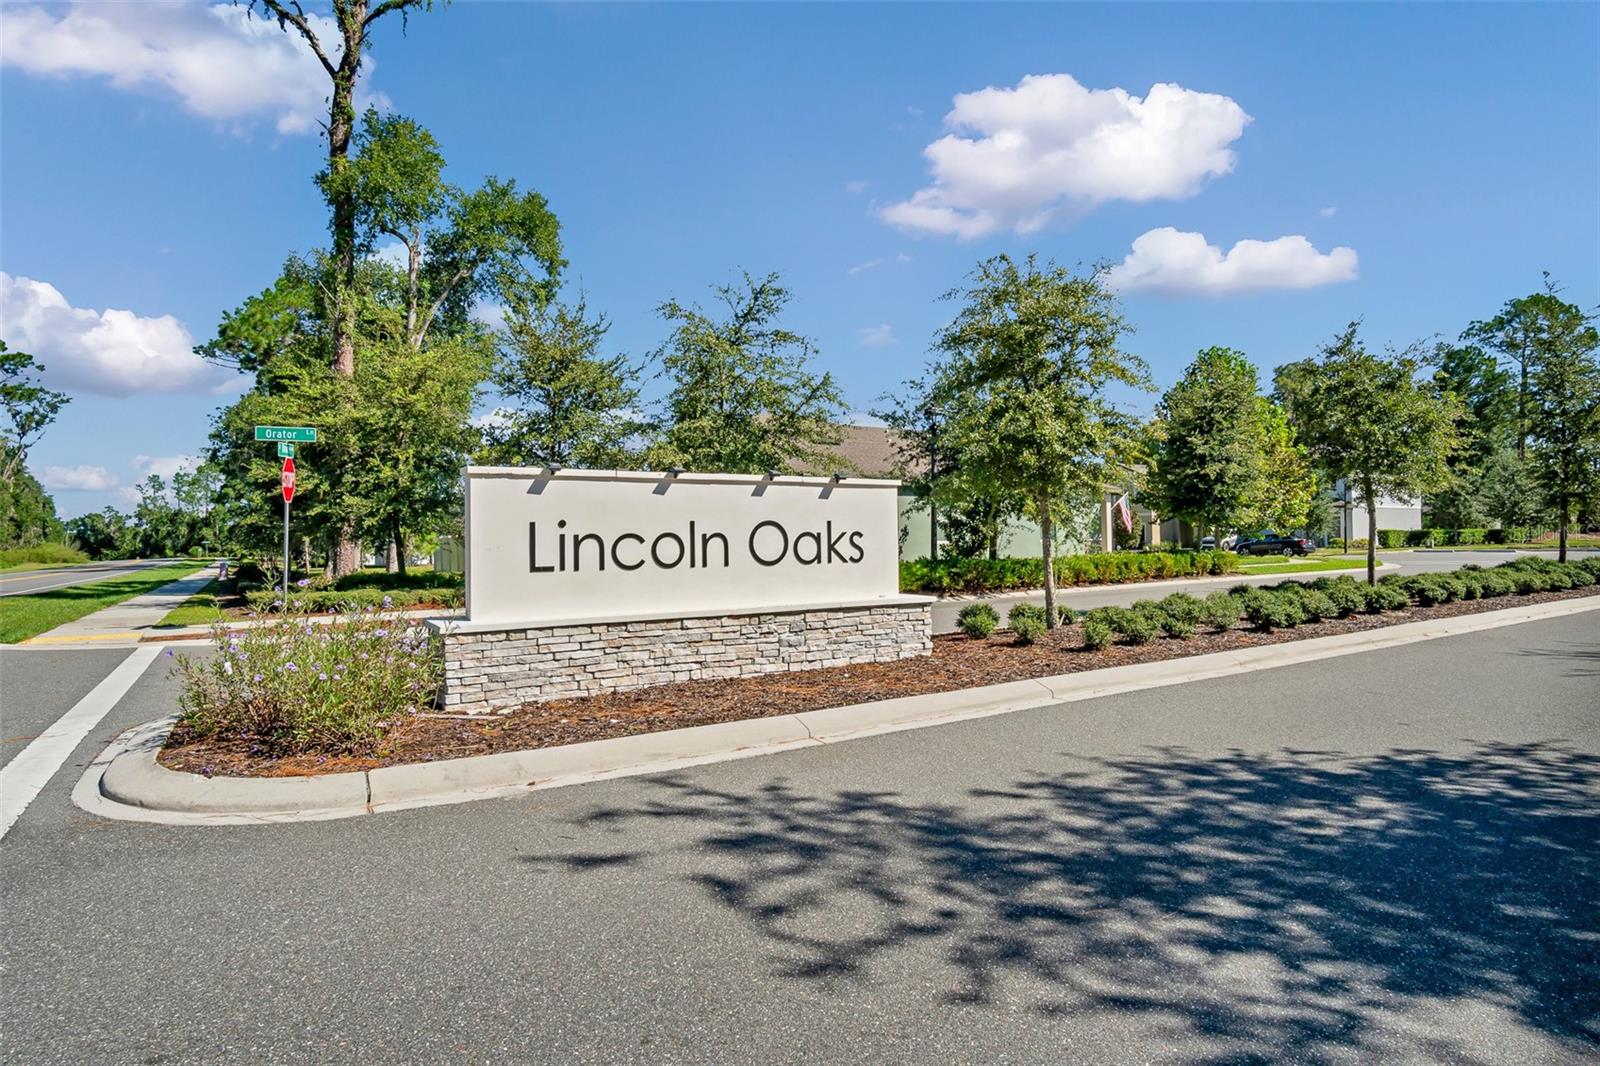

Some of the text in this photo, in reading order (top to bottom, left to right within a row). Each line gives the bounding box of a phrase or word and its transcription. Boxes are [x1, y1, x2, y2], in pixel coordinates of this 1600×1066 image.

[265, 429, 297, 439] Orator
[282, 471, 295, 488] STOP
[528, 519, 865, 573] Lincoln Oaks
